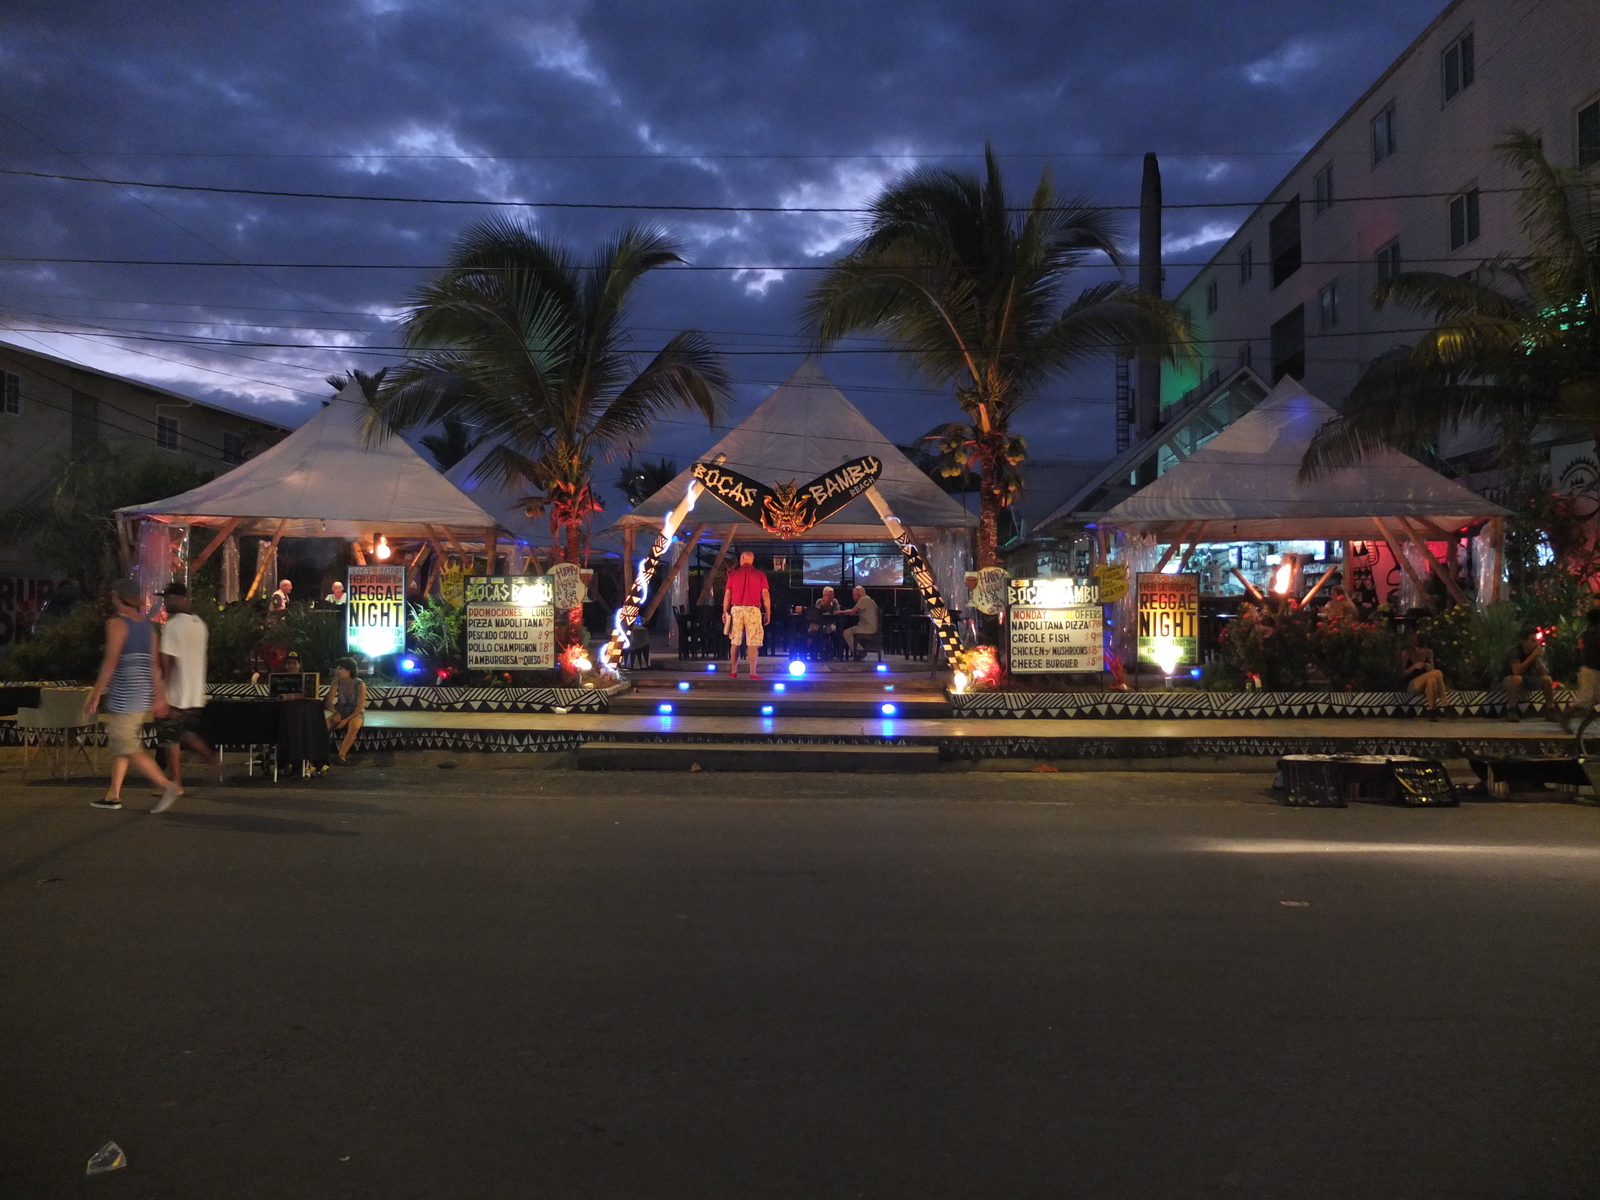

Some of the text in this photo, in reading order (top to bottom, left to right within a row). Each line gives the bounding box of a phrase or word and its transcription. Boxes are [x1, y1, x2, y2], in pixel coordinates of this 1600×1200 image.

[693, 456, 879, 506] BOCAS BAMBU
[849, 475, 876, 498] BEACH
[555, 565, 579, 581] HAPPY
[979, 568, 1005, 585] HAPPY
[349, 585, 403, 601] REGGAE
[1140, 593, 1197, 610] REGGAE
[349, 602, 403, 628] NIGHT
[468, 608, 554, 618] PROMOCIONES LUNES
[1013, 610, 1047, 620] MONDAY
[1074, 610, 1102, 619] OFFERS
[468, 618, 493, 628] PIZZA
[495, 618, 543, 628] NAPOLITANA
[1011, 621, 1063, 631] NAPOLITANA
[1065, 621, 1089, 630] PIZZA
[1139, 611, 1197, 638] NIGHT
[468, 630, 498, 641] PESCADO
[499, 630, 529, 641] CRIOLLO
[1011, 633, 1046, 644] CREOLE
[1049, 633, 1071, 644] FISH
[468, 642, 493, 653] POLLO
[494, 642, 537, 653] CHAMPIGNON
[1011, 646, 1044, 656] CHICKEN
[1052, 646, 1088, 656] MUSHROOMS
[468, 655, 519, 665] HAMBURGUESA
[523, 655, 542, 667] QUESO
[1011, 658, 1043, 669] CHEESE
[1045, 658, 1079, 669] BURGUER
